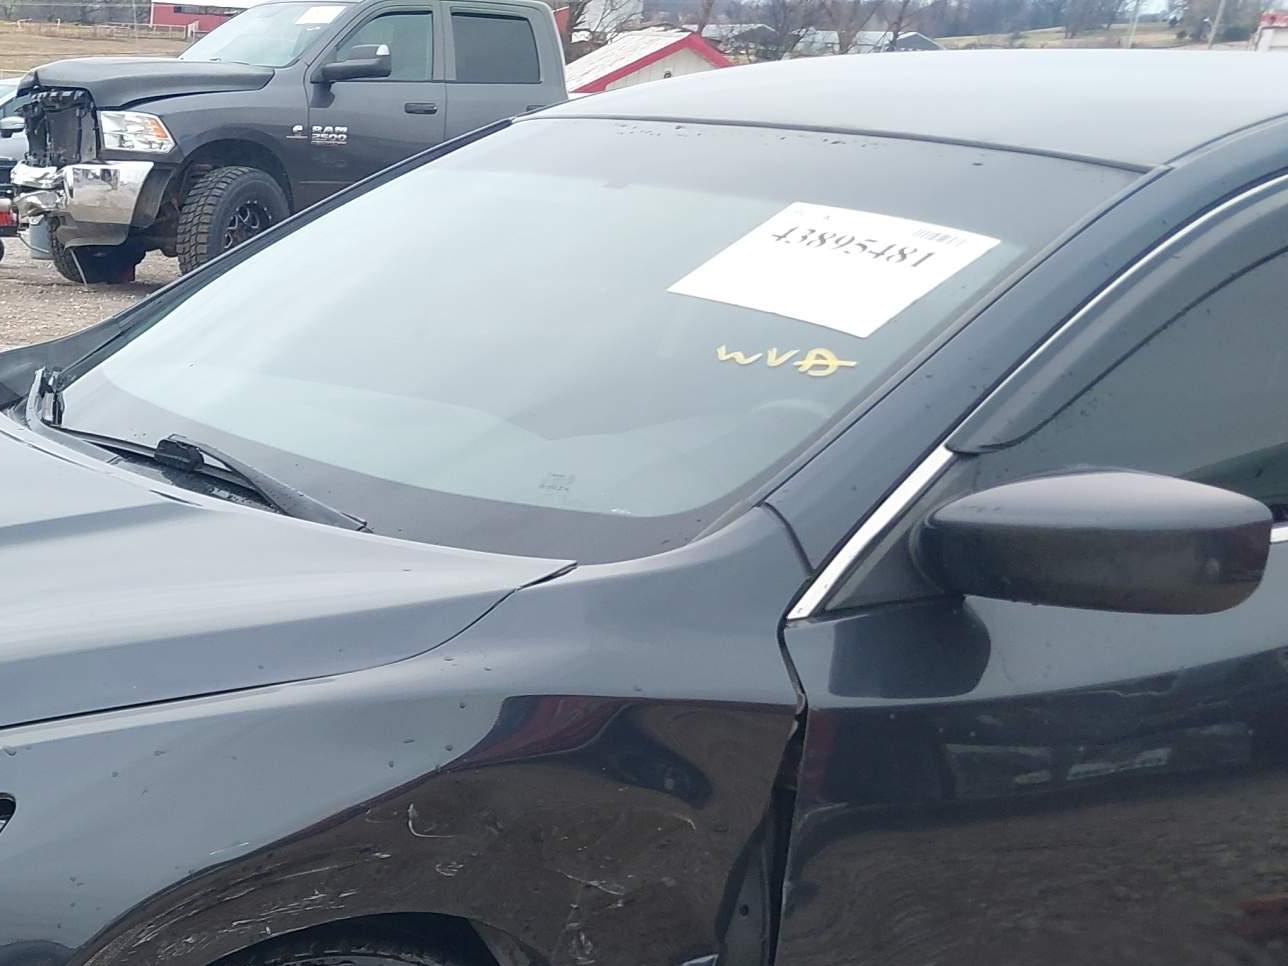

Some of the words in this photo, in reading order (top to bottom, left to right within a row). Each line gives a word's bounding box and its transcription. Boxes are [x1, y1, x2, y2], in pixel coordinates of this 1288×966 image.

[311, 125, 348, 134] RAM
[311, 133, 348, 142] 2500
[770, 226, 936, 268] 43895481
